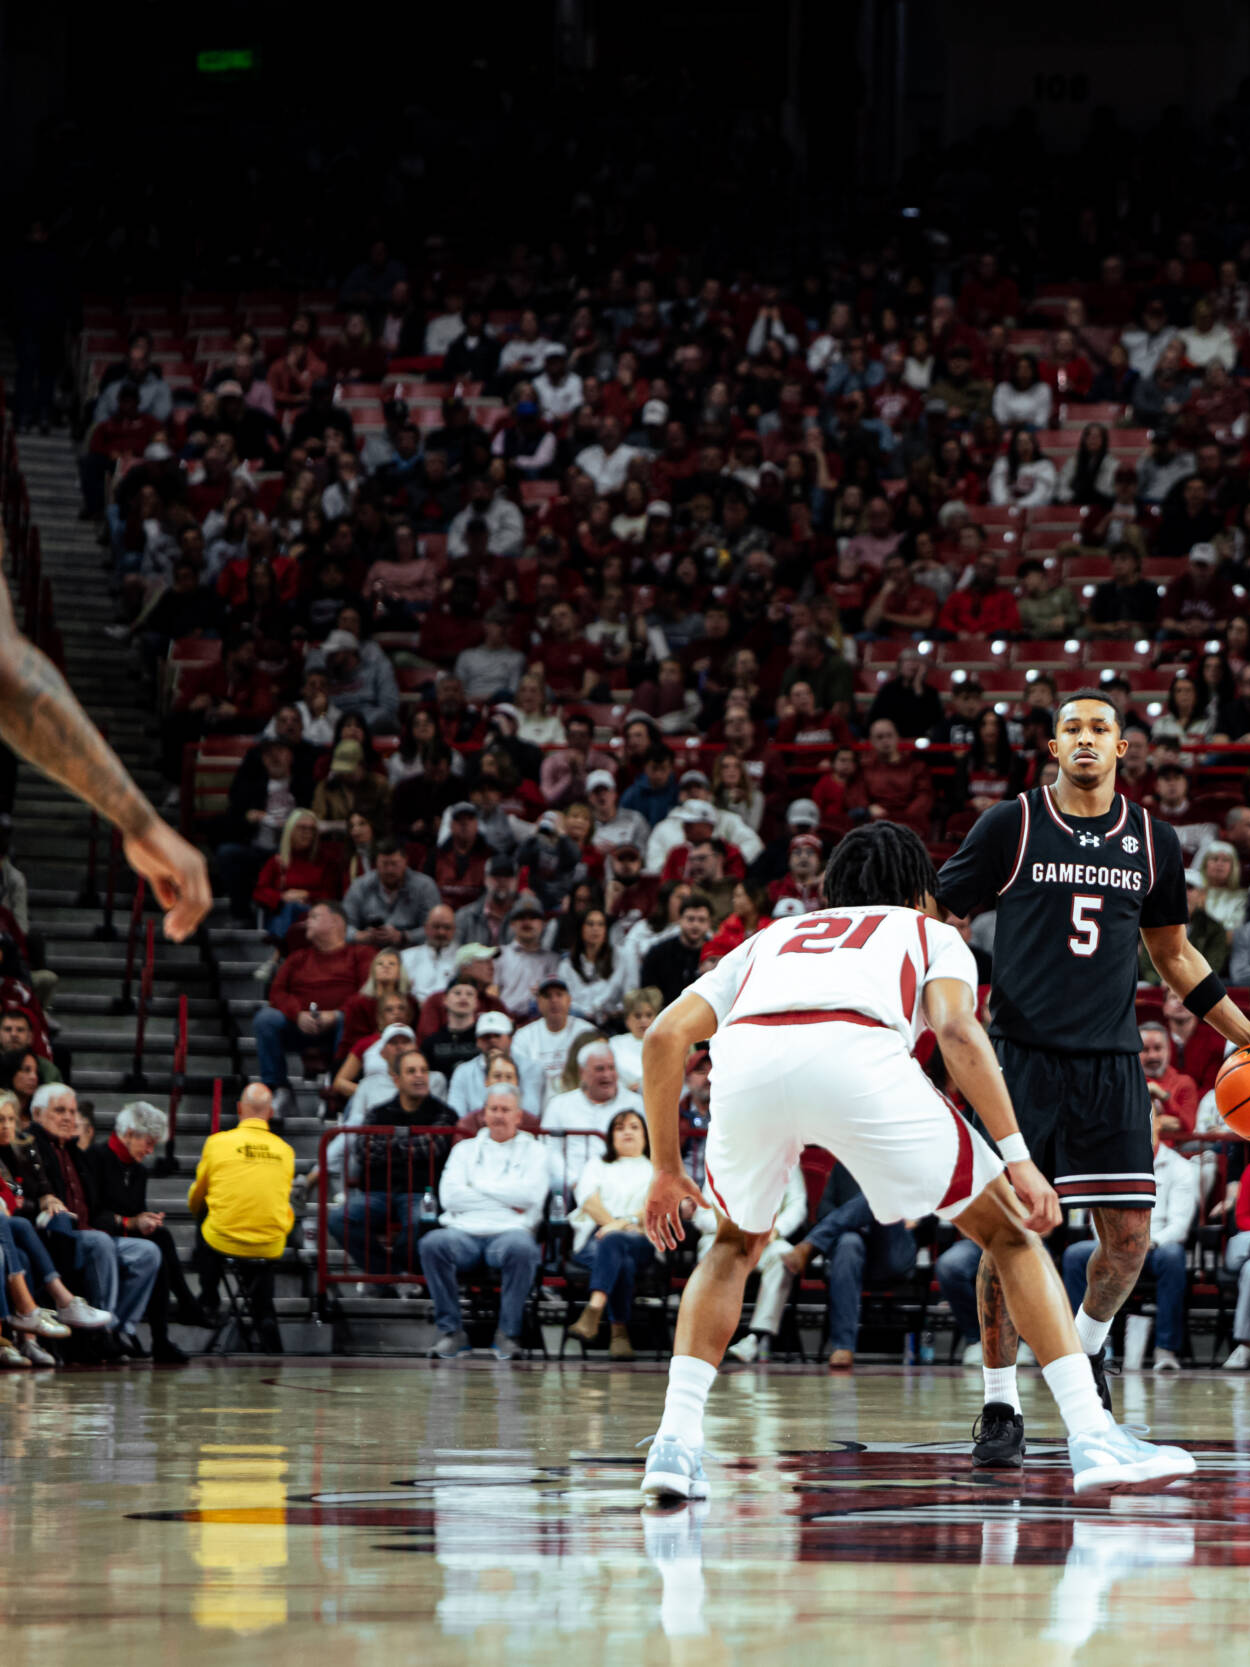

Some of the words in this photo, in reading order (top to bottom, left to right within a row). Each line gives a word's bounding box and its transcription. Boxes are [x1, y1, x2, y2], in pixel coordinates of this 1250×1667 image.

[1121, 835, 1140, 854] SEC
[1032, 862, 1143, 892] GAMECOCKS
[776, 913, 889, 957] 21
[1067, 893, 1104, 958] 5
